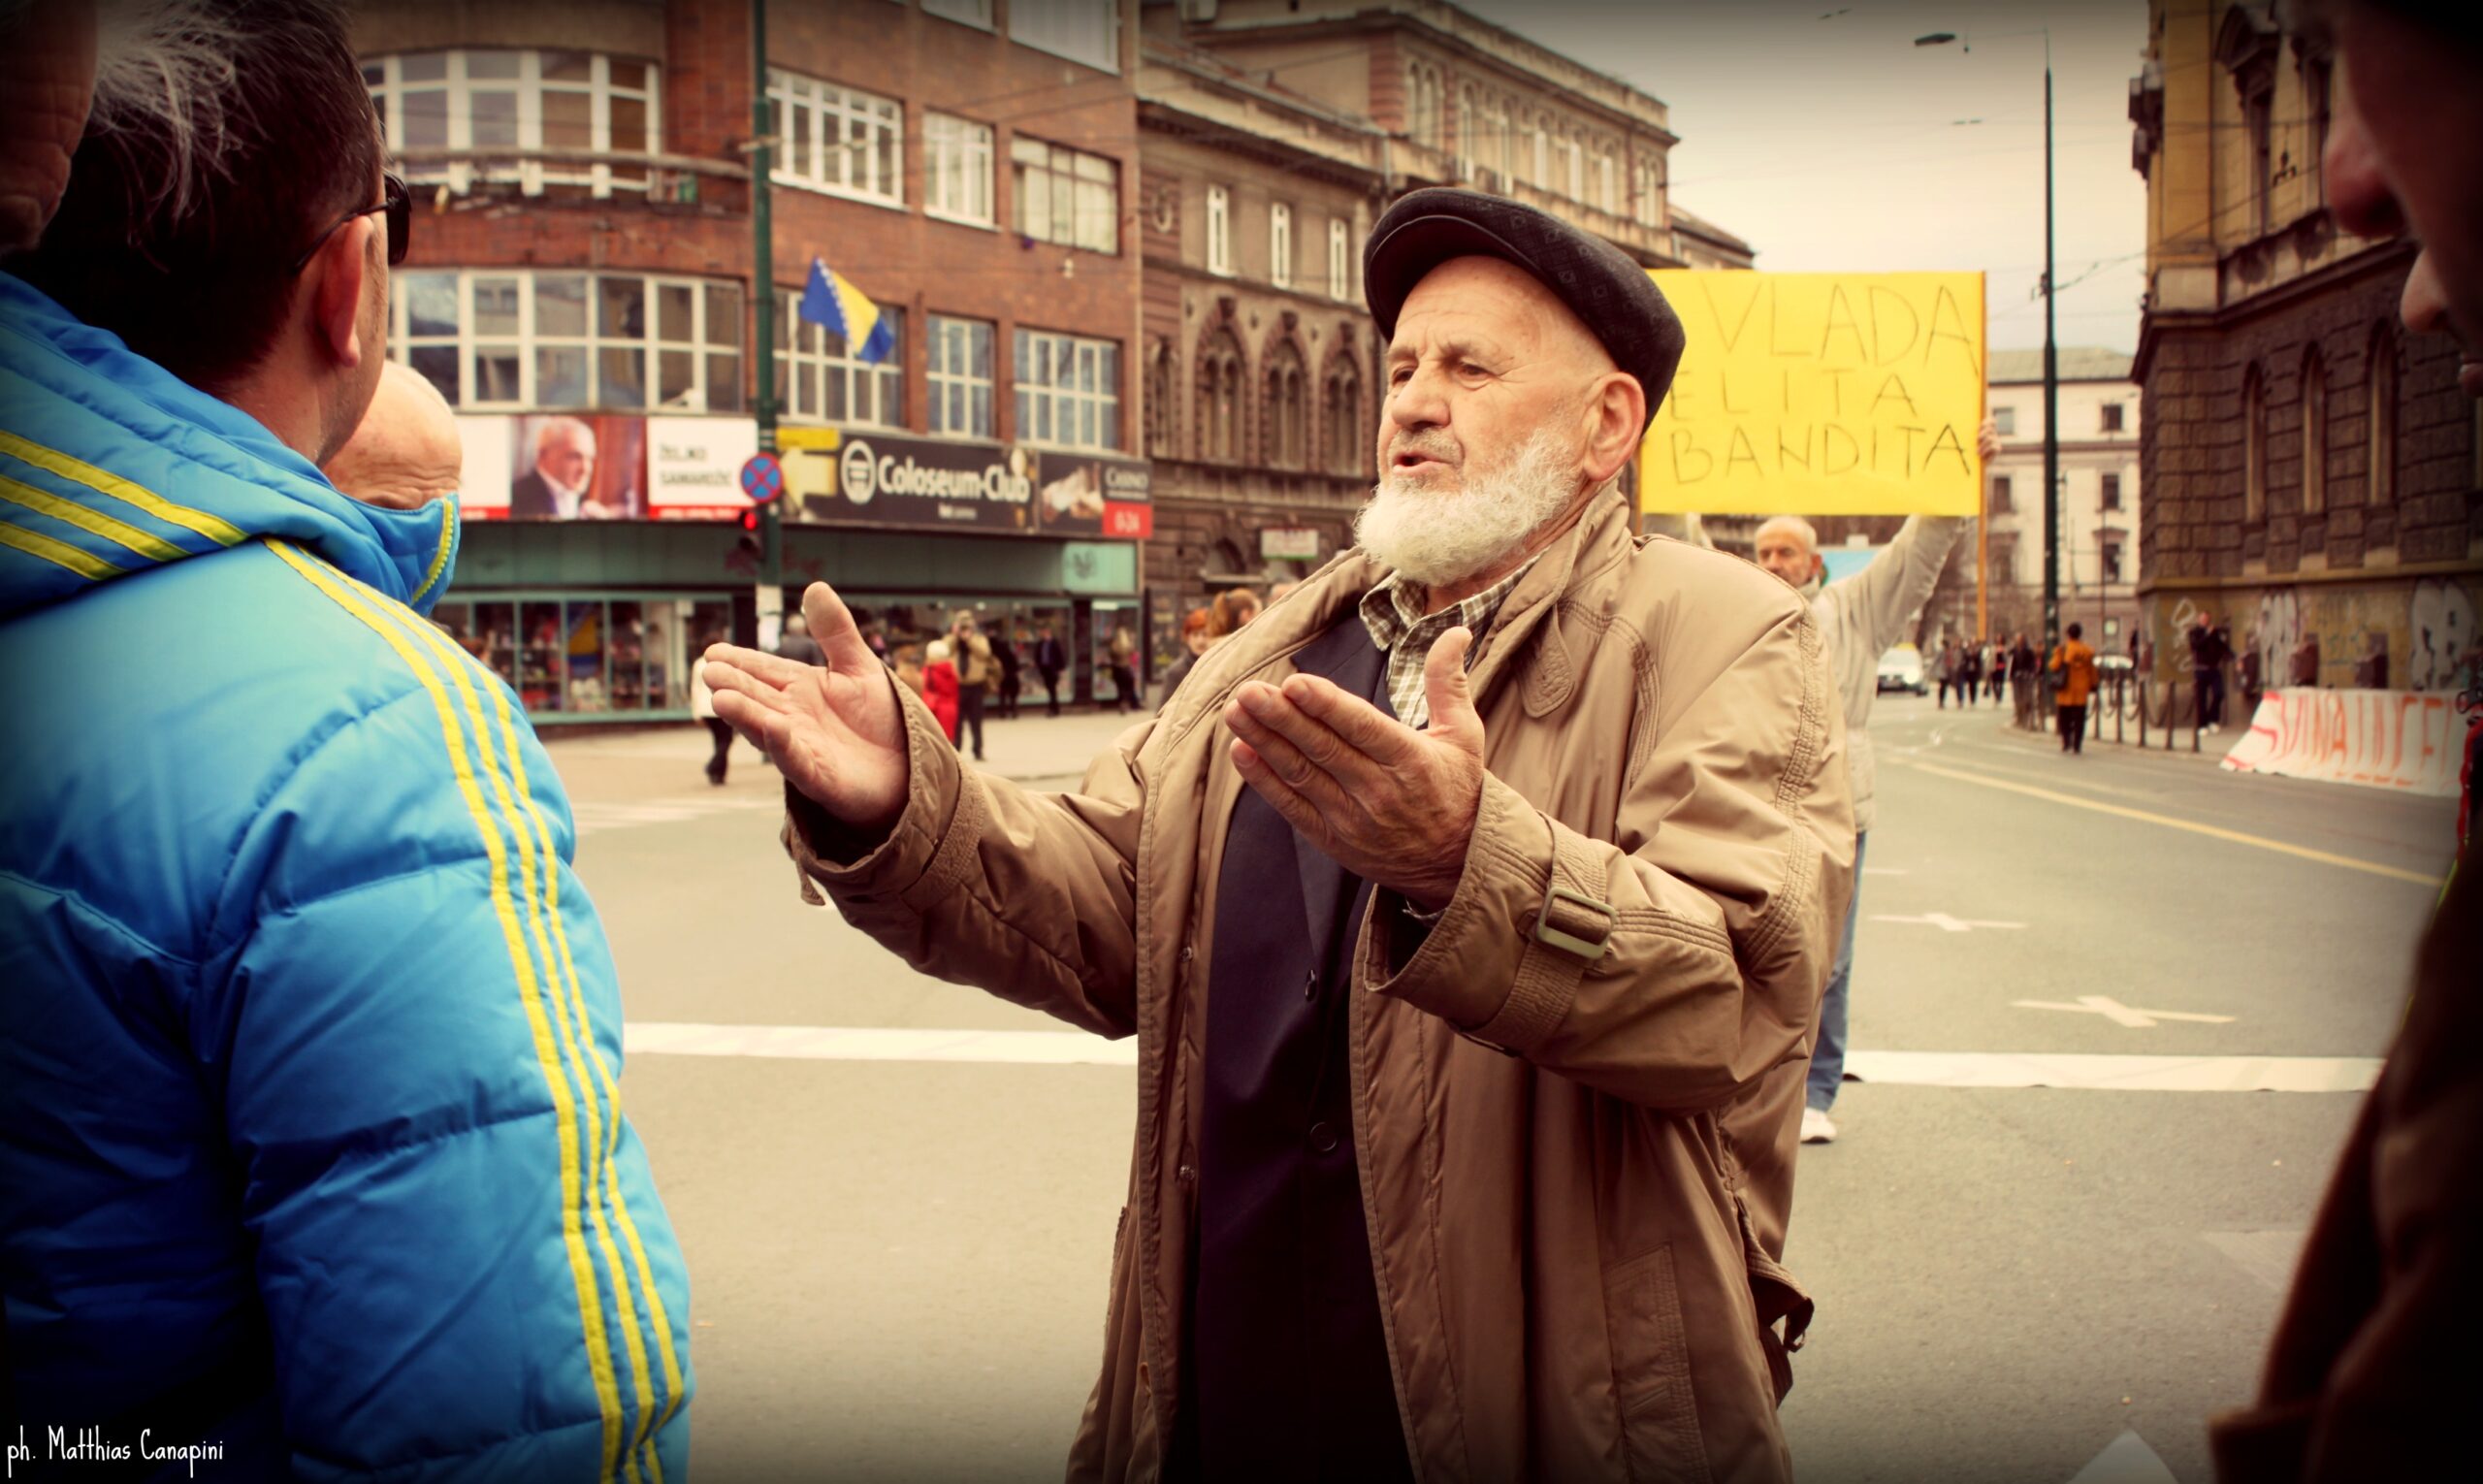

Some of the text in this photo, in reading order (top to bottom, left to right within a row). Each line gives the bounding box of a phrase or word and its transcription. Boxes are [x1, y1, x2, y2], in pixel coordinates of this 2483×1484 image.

[1699, 276, 1980, 377] VLADA
[1670, 369, 1918, 422] ELITA
[1670, 424, 1972, 485] BANDITA
